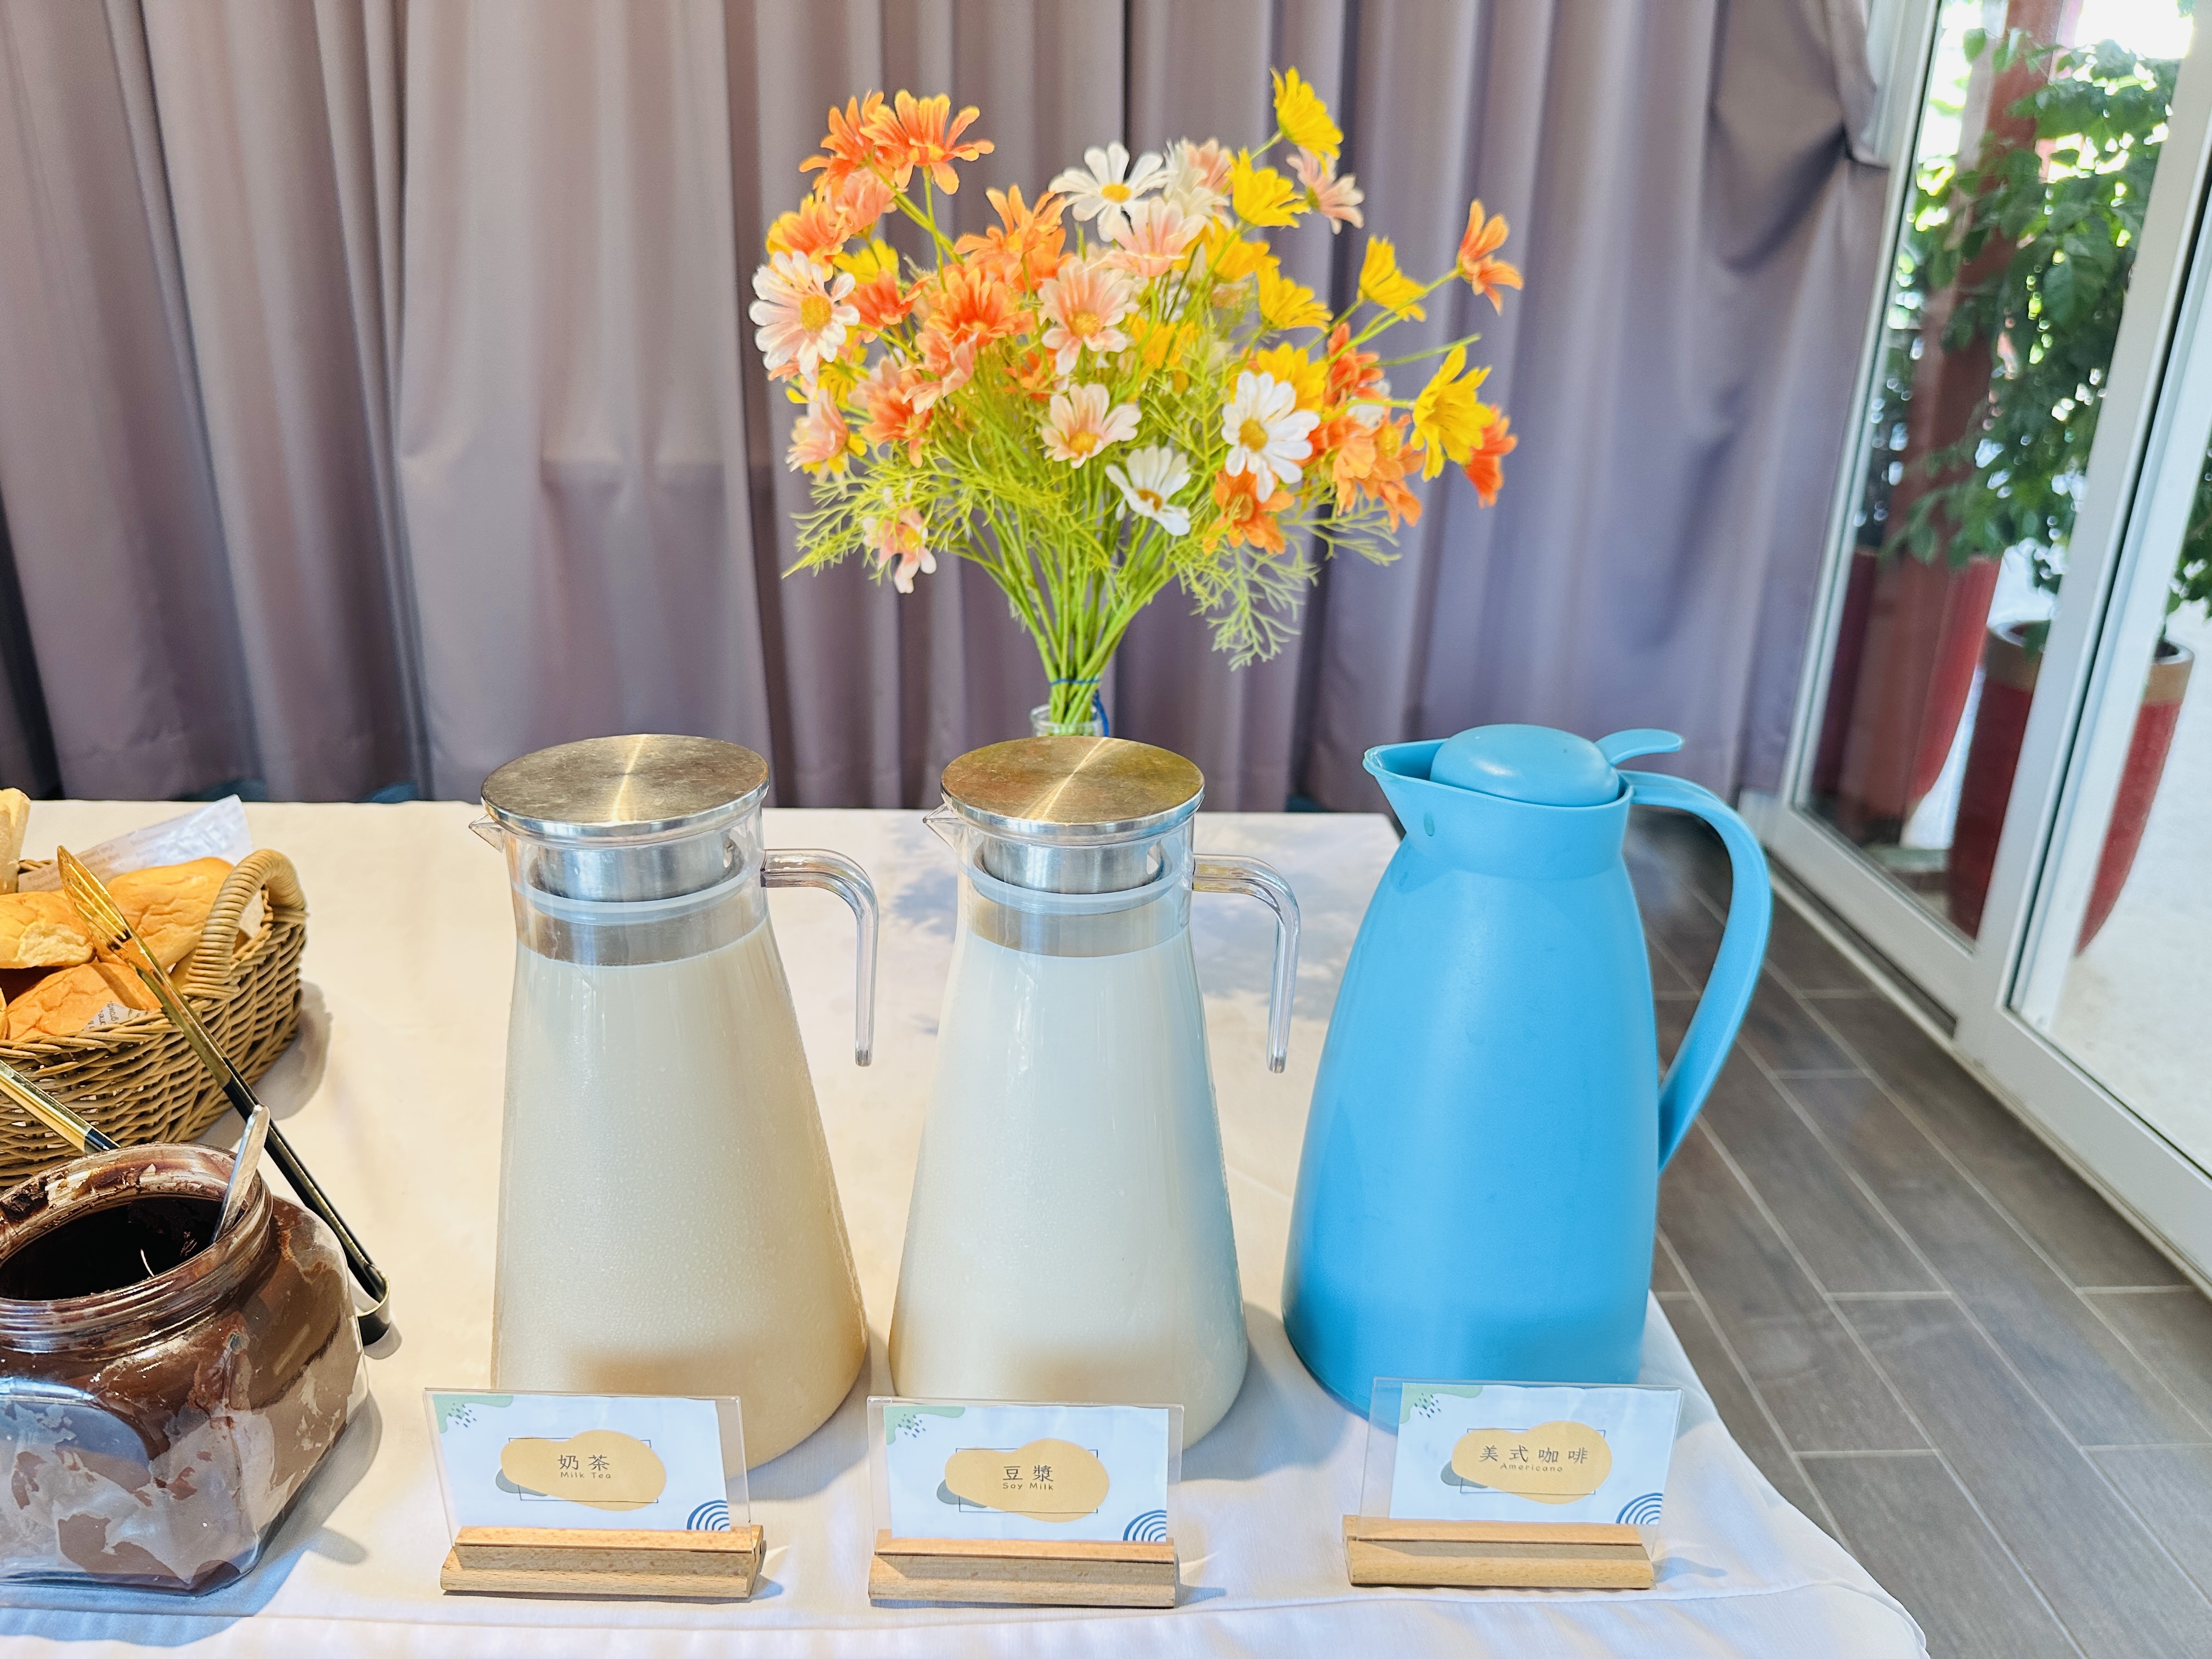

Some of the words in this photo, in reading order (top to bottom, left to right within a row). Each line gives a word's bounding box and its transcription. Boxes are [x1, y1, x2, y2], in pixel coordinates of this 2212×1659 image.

[557, 1454, 610, 1471] 奶茶
[1479, 1444, 1589, 1464] 美式咖啡
[1002, 1464, 1054, 1482] 豆漿
[1500, 1463, 1563, 1472] Americano
